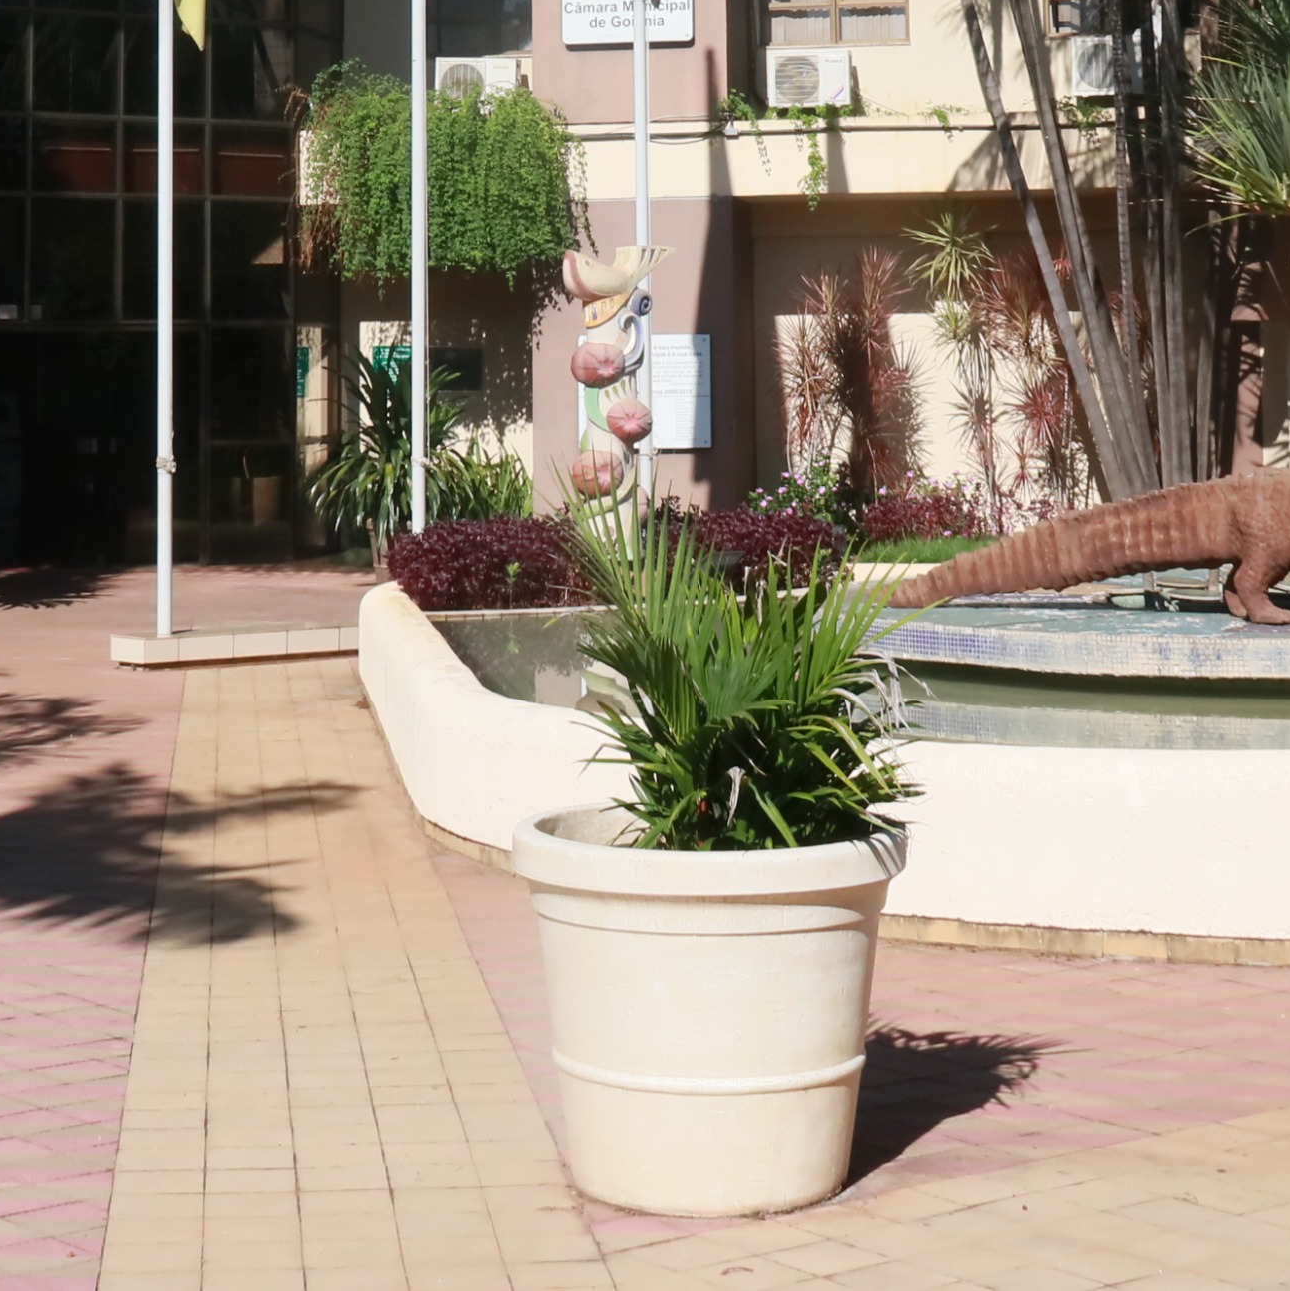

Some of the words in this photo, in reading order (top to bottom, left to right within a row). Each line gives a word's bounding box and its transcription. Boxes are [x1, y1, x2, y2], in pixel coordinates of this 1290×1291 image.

[564, 1, 618, 14] Câmara
[623, 0, 691, 13] Mncipal
[589, 17, 606, 28] de
[611, 15, 665, 28] Goinia
